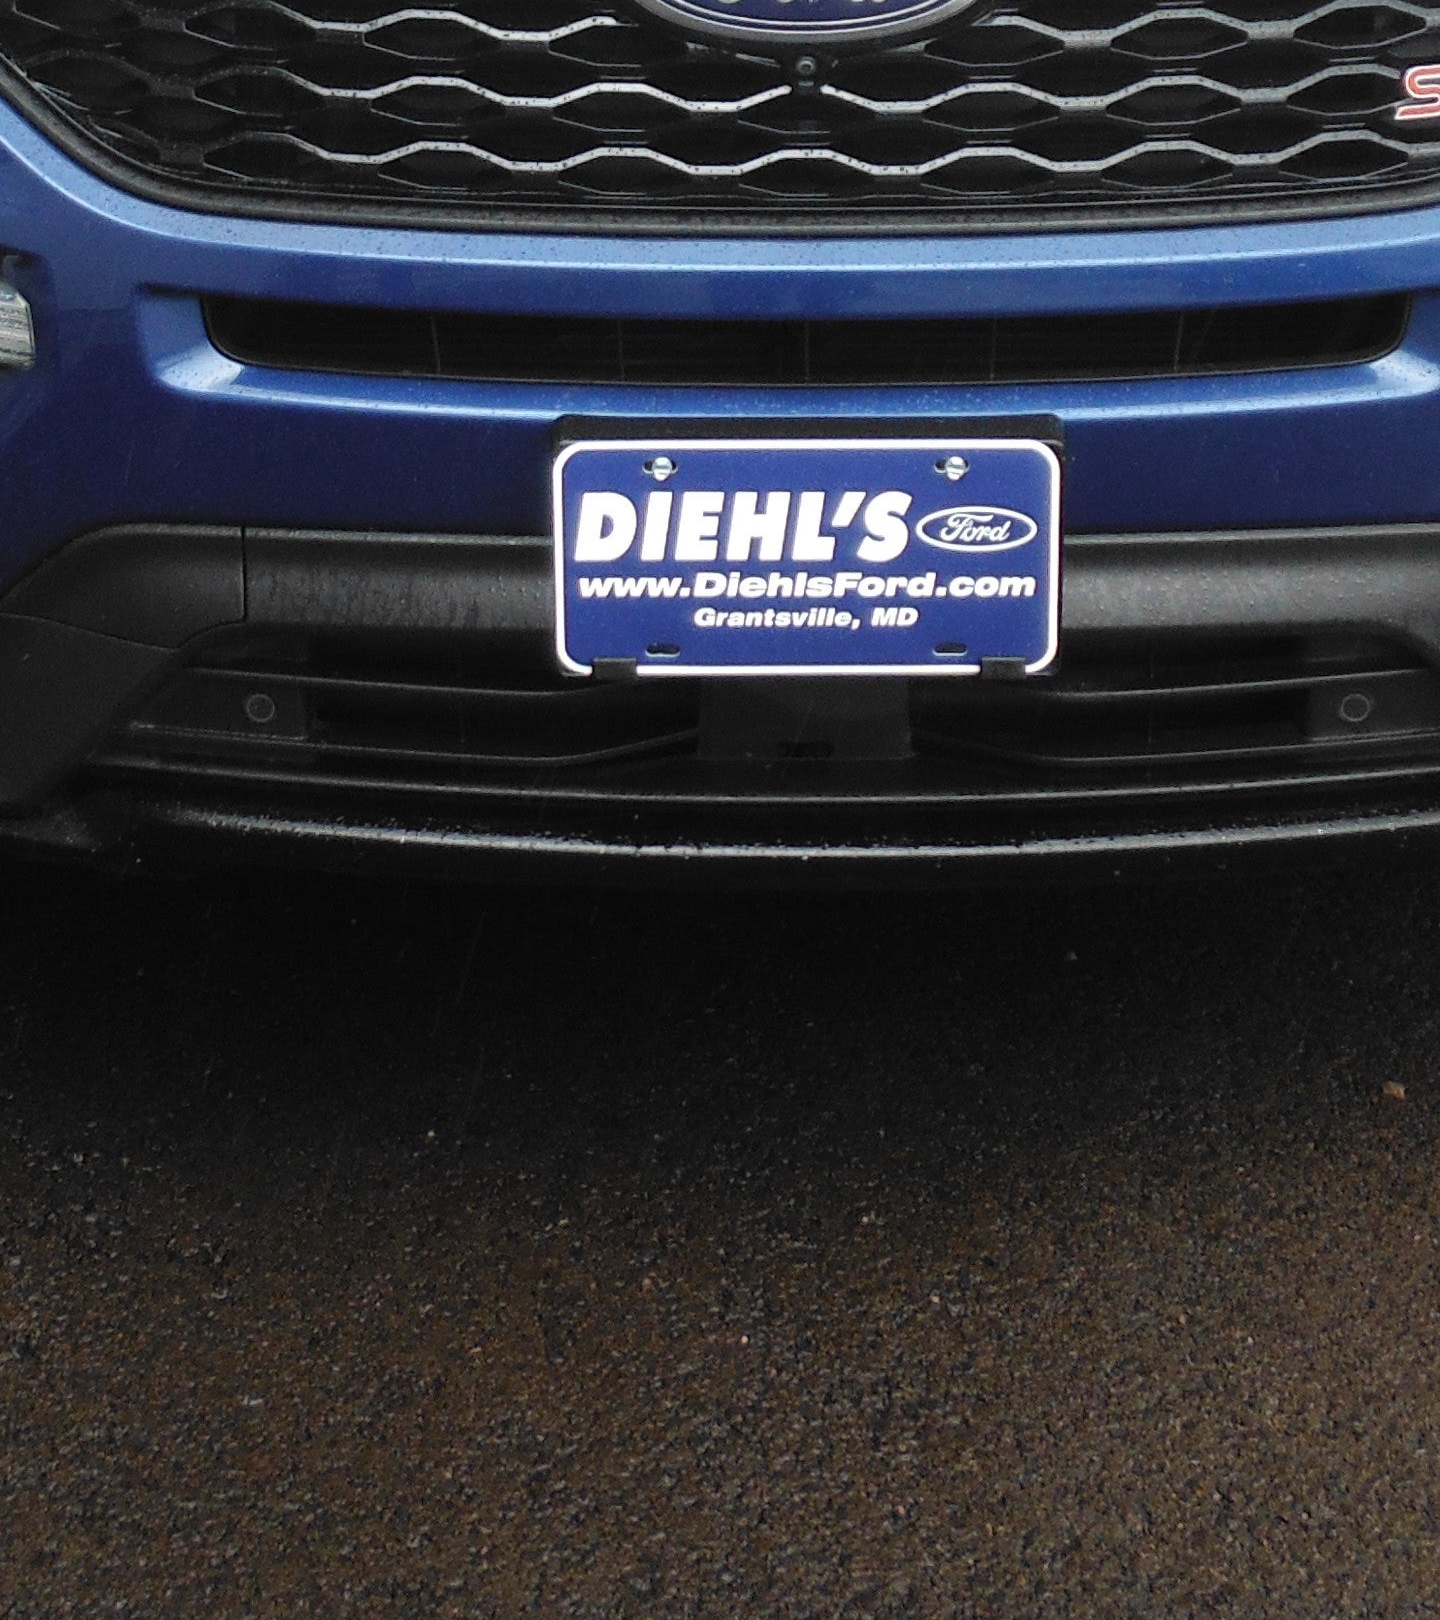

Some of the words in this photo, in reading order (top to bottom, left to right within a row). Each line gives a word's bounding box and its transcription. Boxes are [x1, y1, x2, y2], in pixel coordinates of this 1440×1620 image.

[574, 490, 913, 563] DIEHL'S
[939, 511, 1012, 543] Ford
[578, 571, 1037, 599] www.DiehlsFord.com
[693, 606, 861, 630] Grantsville,
[870, 606, 919, 628] MD
